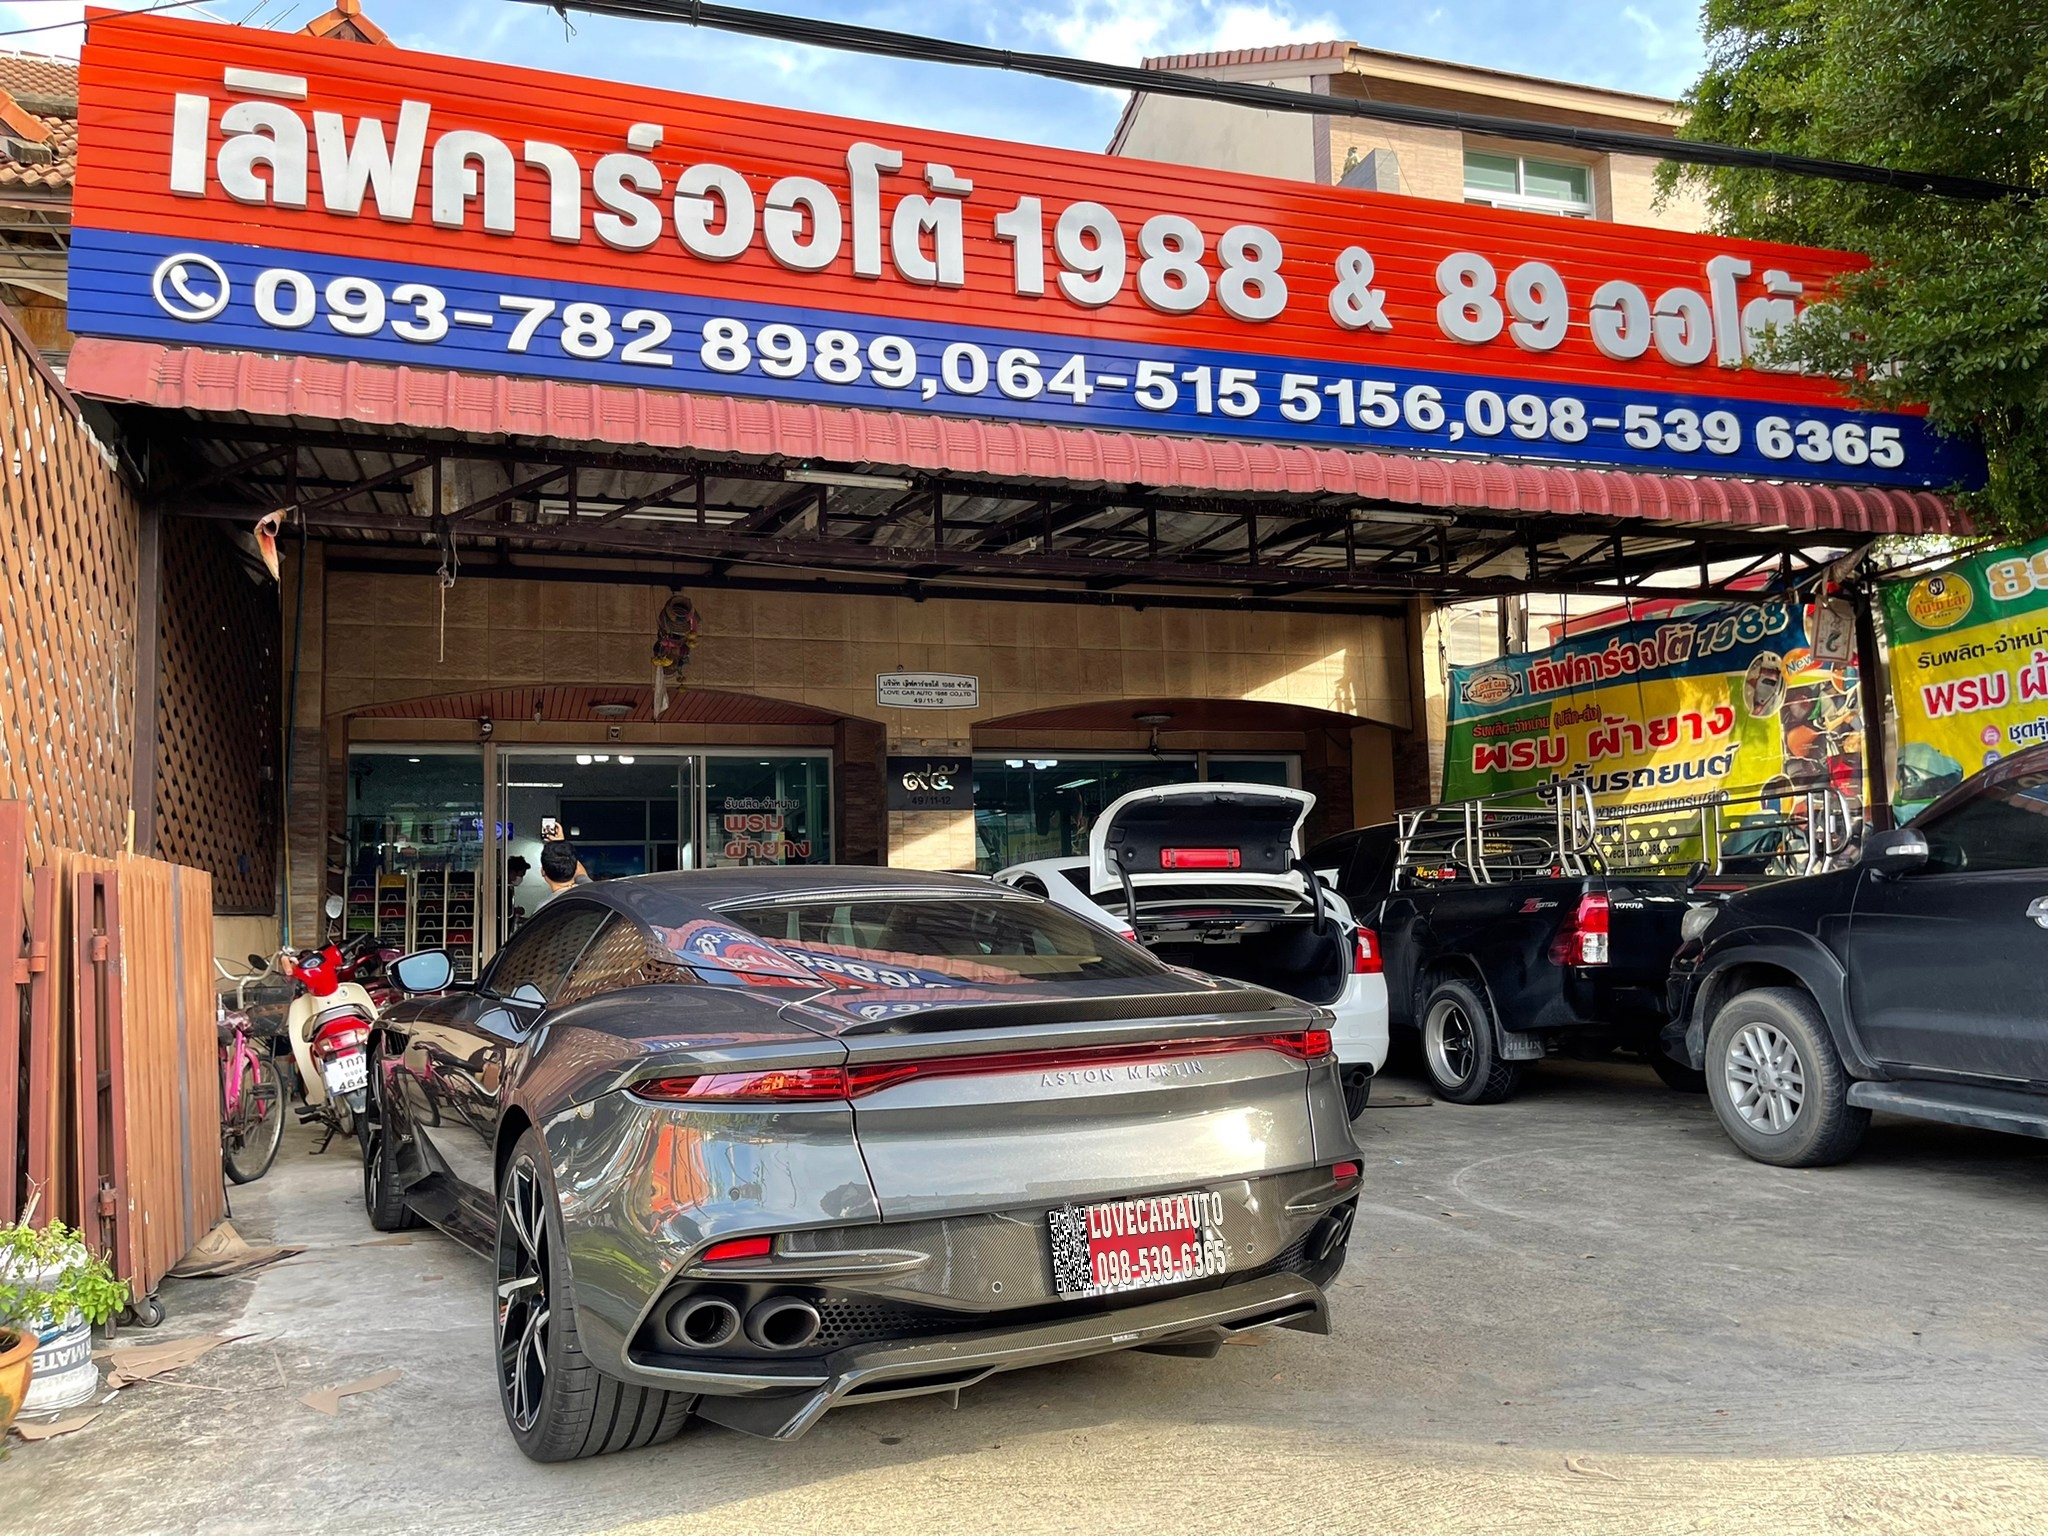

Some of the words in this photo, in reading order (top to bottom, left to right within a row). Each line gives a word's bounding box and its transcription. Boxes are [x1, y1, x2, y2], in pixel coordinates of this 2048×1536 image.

[169, 66, 973, 289] เลิฟคาร์ออโต้
[993, 195, 1289, 323] 1988
[1328, 245, 1394, 332] &
[1435, 251, 1570, 353] 89
[253, 268, 673, 366] 093-782
[1756, 415, 1905, 468] 6365
[1930, 580, 1943, 594] 89
[1528, 623, 1698, 693] เลิฟคาร์ออโต้
[1699, 602, 1789, 658] 1988
[1785, 653, 1814, 675] New
[1482, 690, 1503, 700] AUTO
[1922, 672, 2009, 718] พรม
[1473, 735, 1567, 773] พรม
[1589, 704, 1736, 760] ผ้ายาง
[724, 814, 784, 832] พรม
[725, 833, 811, 858] ผ้ายาง
[1041, 1068, 1114, 1087] ASTON
[1128, 1060, 1204, 1080] MARTIN
